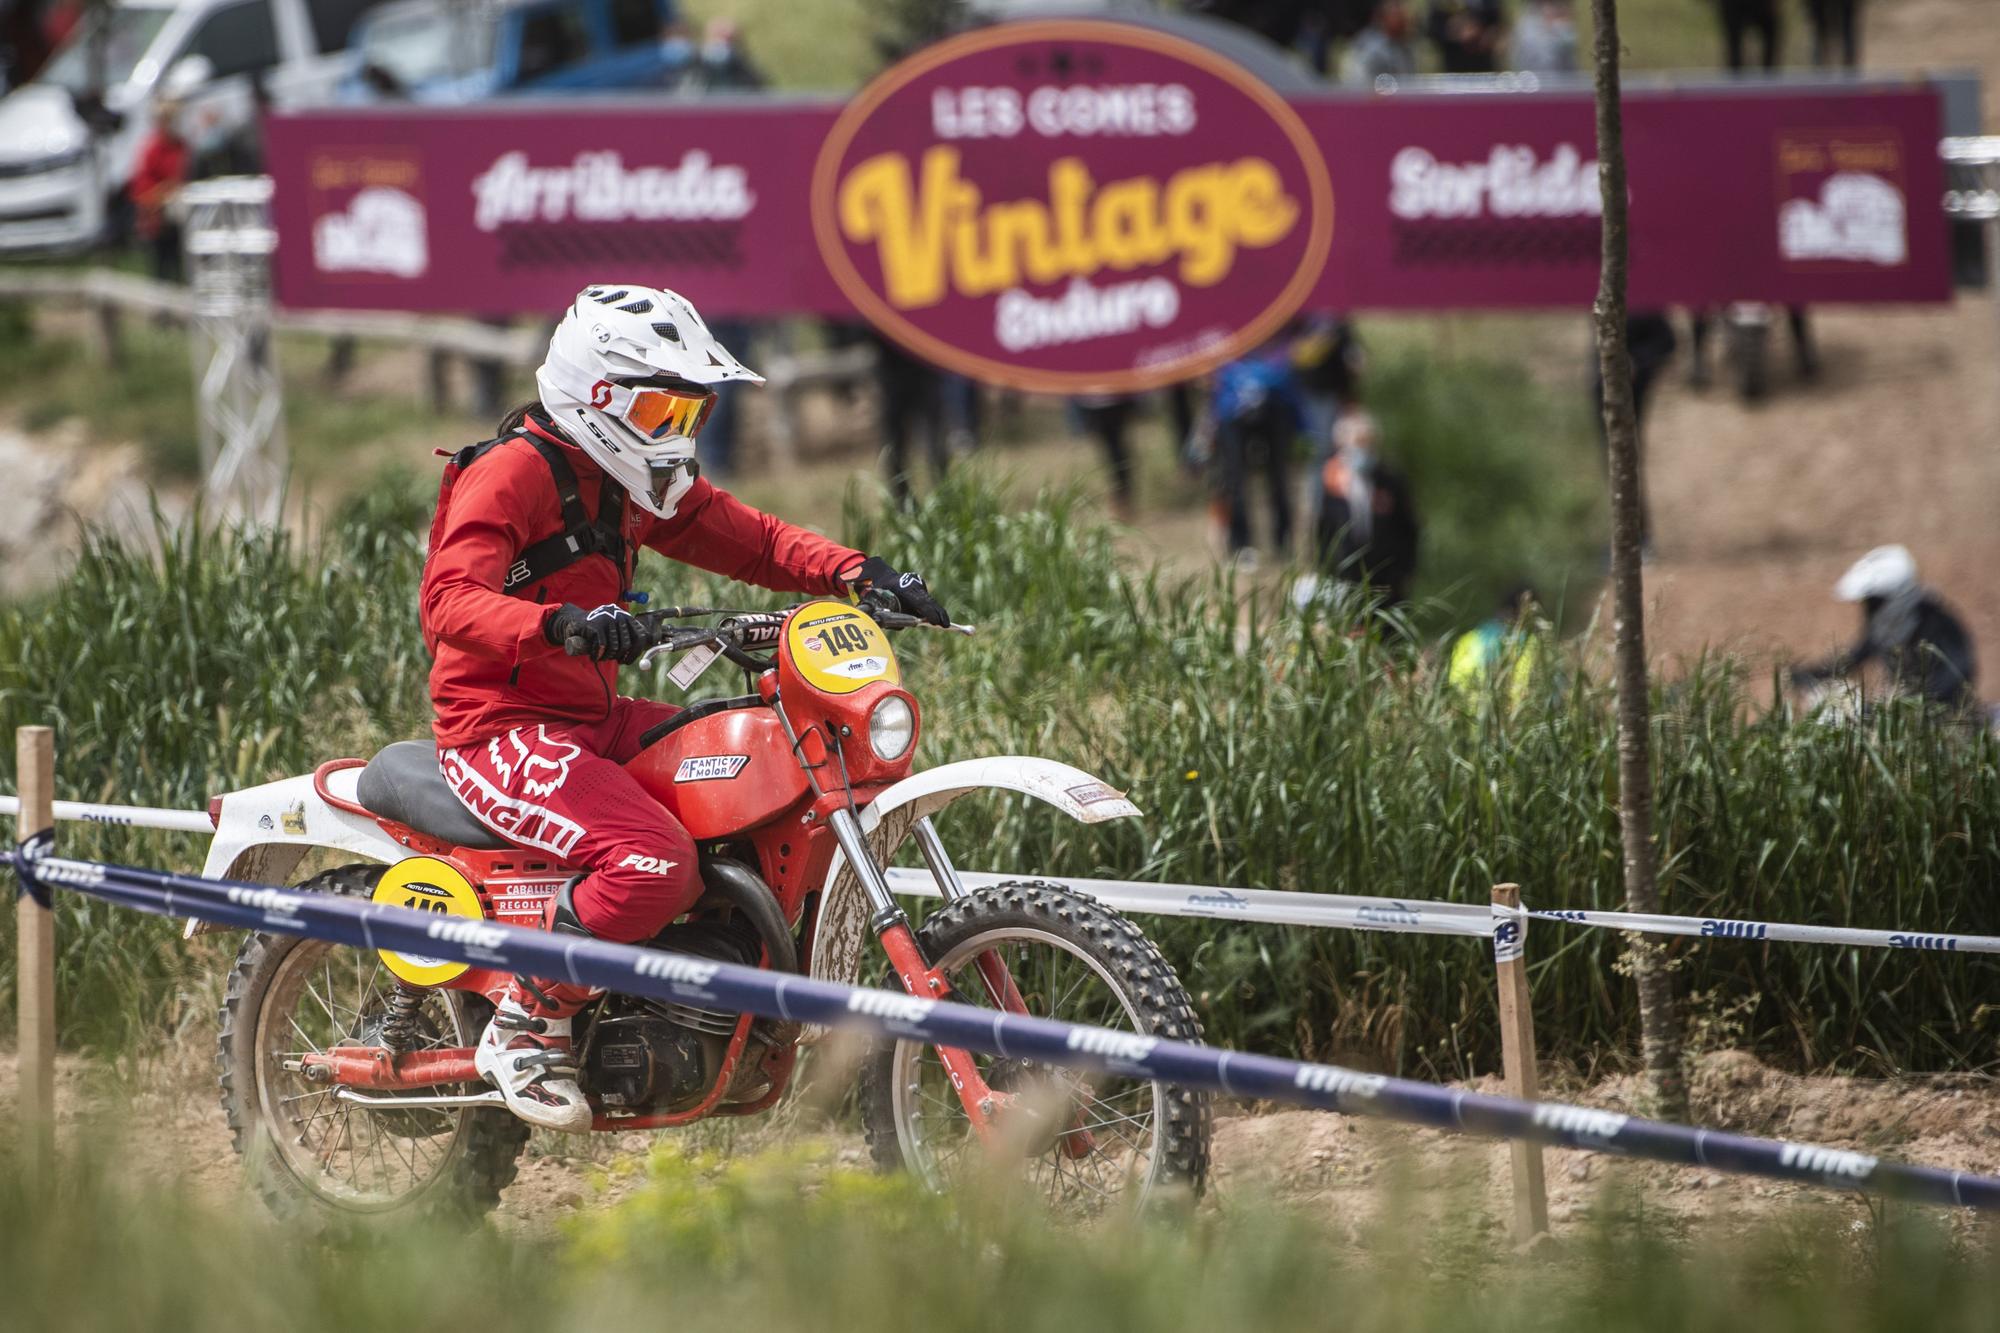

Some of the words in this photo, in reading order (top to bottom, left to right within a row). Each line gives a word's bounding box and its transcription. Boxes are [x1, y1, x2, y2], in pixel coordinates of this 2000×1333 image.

[931, 86, 1024, 138] LES
[471, 148, 757, 232] Arribada
[838, 144, 1299, 311] Vintage
[994, 277, 1181, 352] Enduro
[817, 623, 870, 657] 149
[689, 757, 728, 778] FANTIC
[696, 765, 728, 778] MOTOR
[617, 853, 679, 876] FOX
[506, 883, 560, 896] CABALLER
